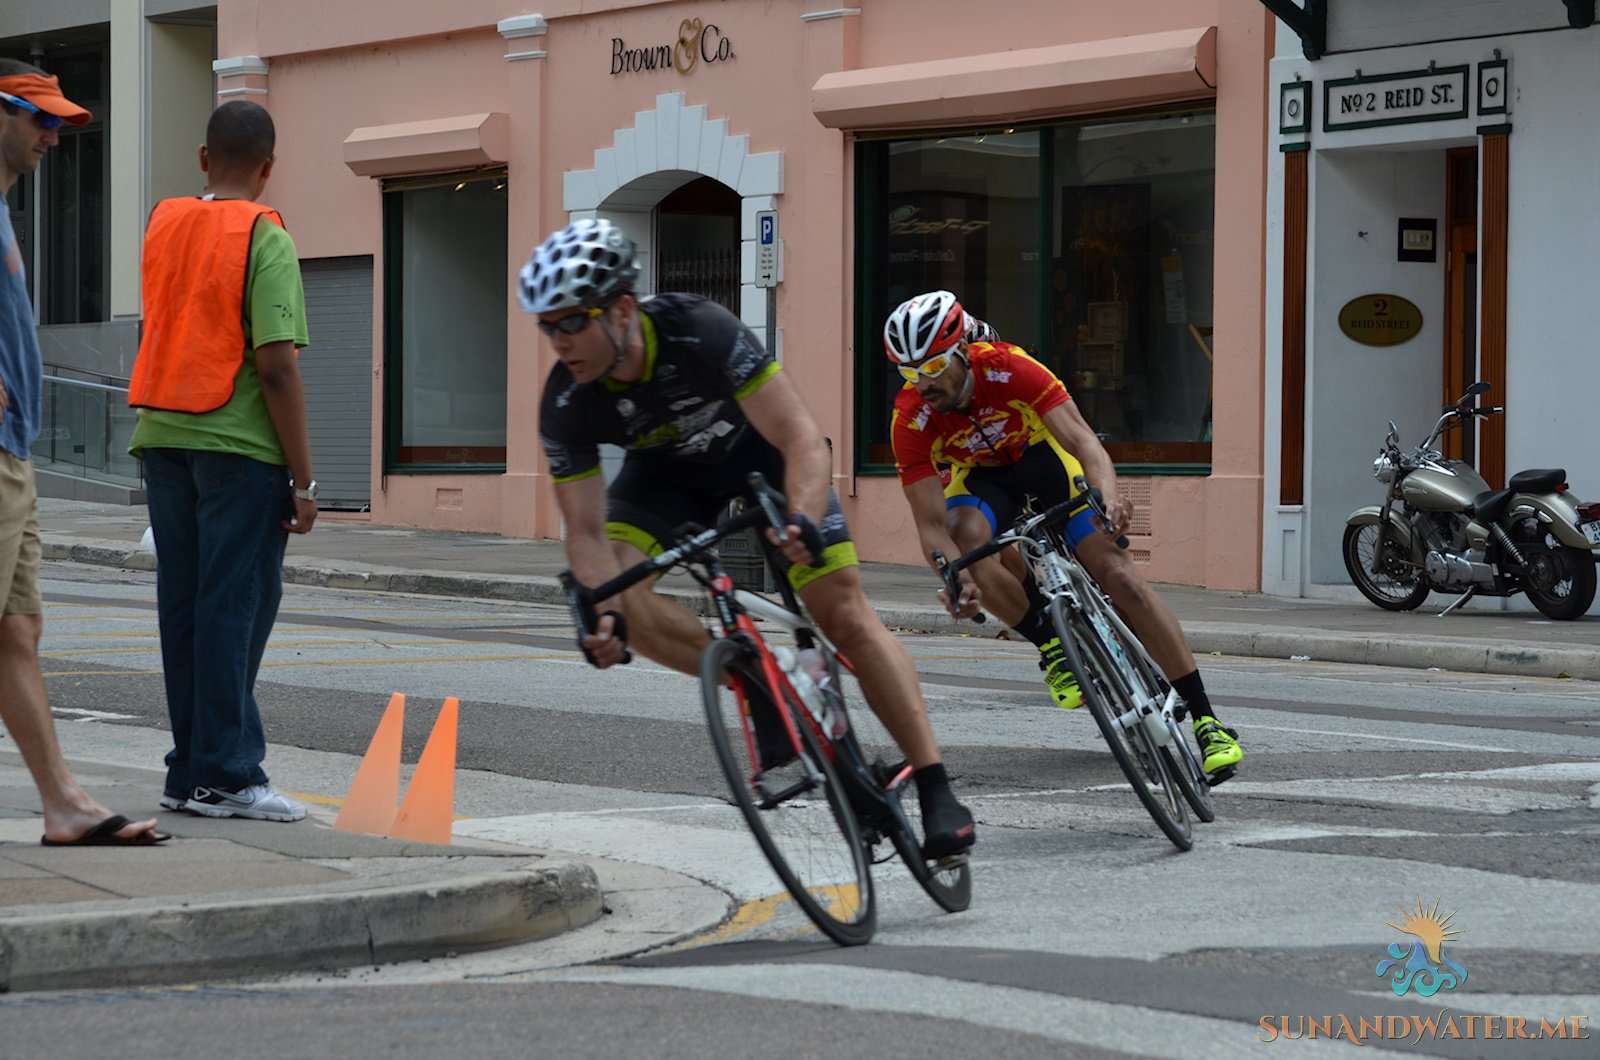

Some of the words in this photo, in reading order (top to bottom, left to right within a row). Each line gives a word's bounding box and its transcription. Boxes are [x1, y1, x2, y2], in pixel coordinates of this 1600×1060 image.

[610, 37, 673, 75] Brown
[701, 24, 734, 63] Co.
[1384, 87, 1425, 110] REID
[1431, 84, 1455, 105] ST.
[762, 220, 772, 241] P
[1374, 299, 1388, 316] 2
[1351, 319, 1375, 329] REID
[1375, 319, 1412, 330] STREET
